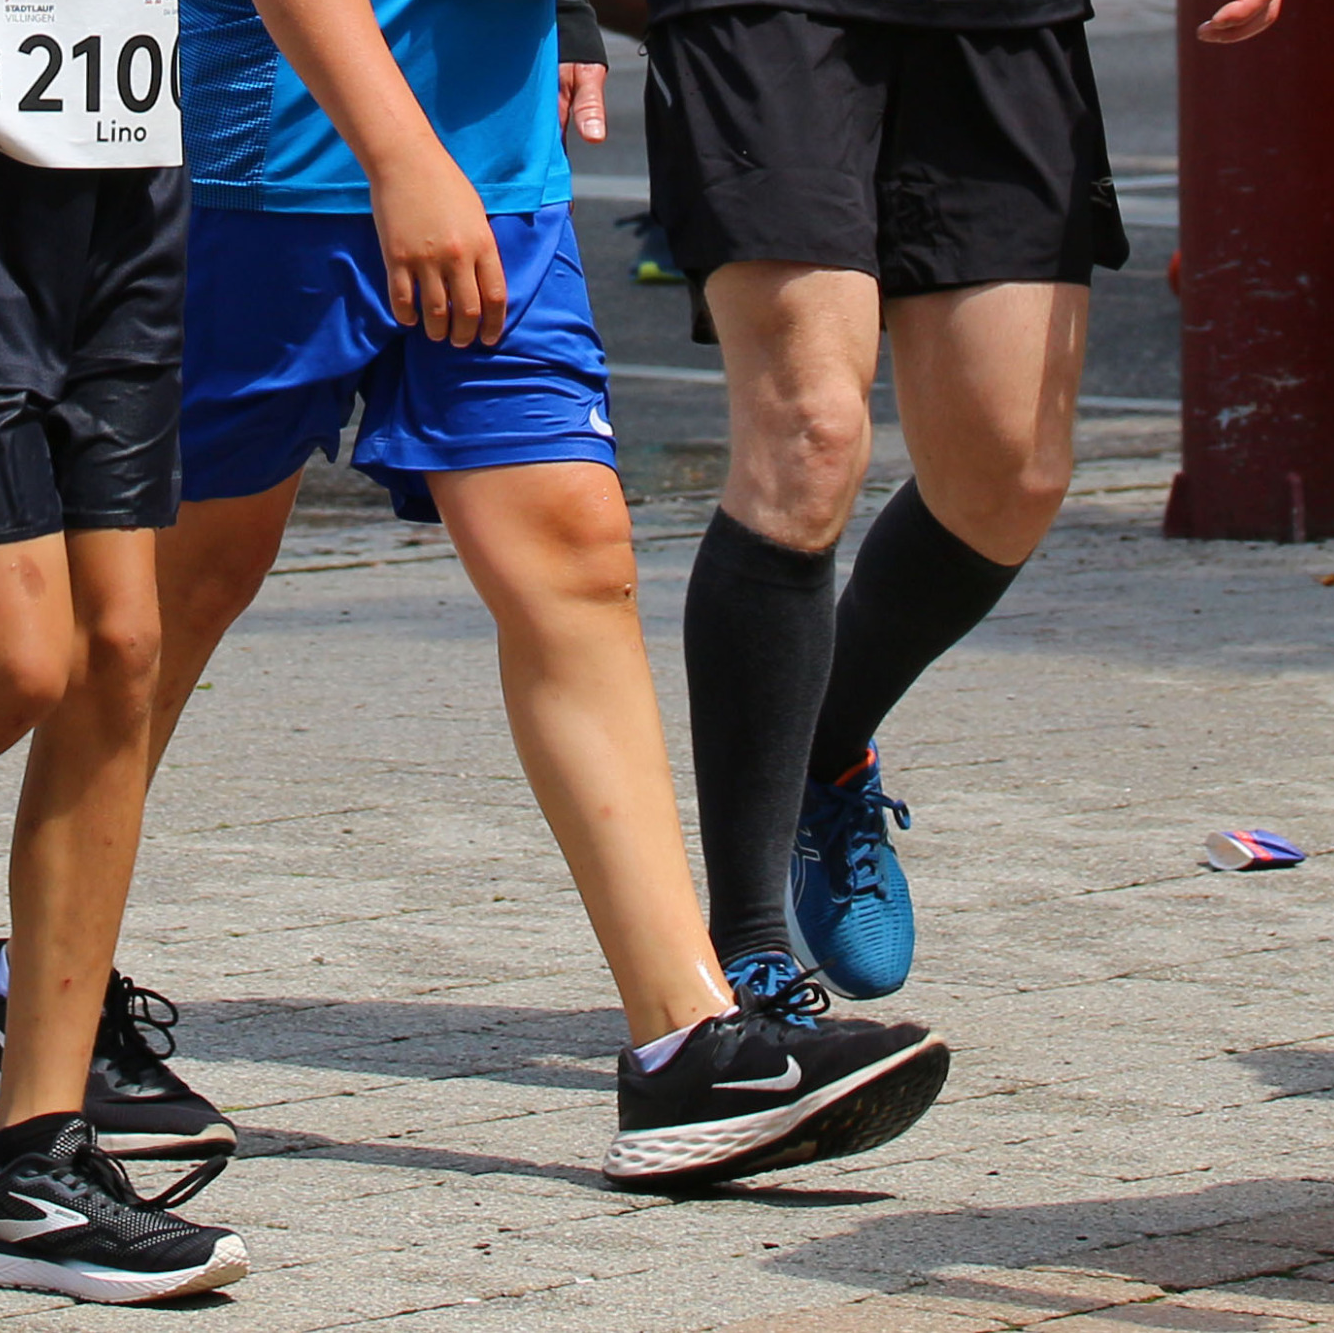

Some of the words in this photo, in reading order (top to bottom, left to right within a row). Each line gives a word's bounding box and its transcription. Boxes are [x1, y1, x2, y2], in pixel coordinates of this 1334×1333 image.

[5, 4, 55, 13] STADTLAUF
[5, 13, 55, 23] VILLINGEN
[96, 120, 147, 142] Lino
